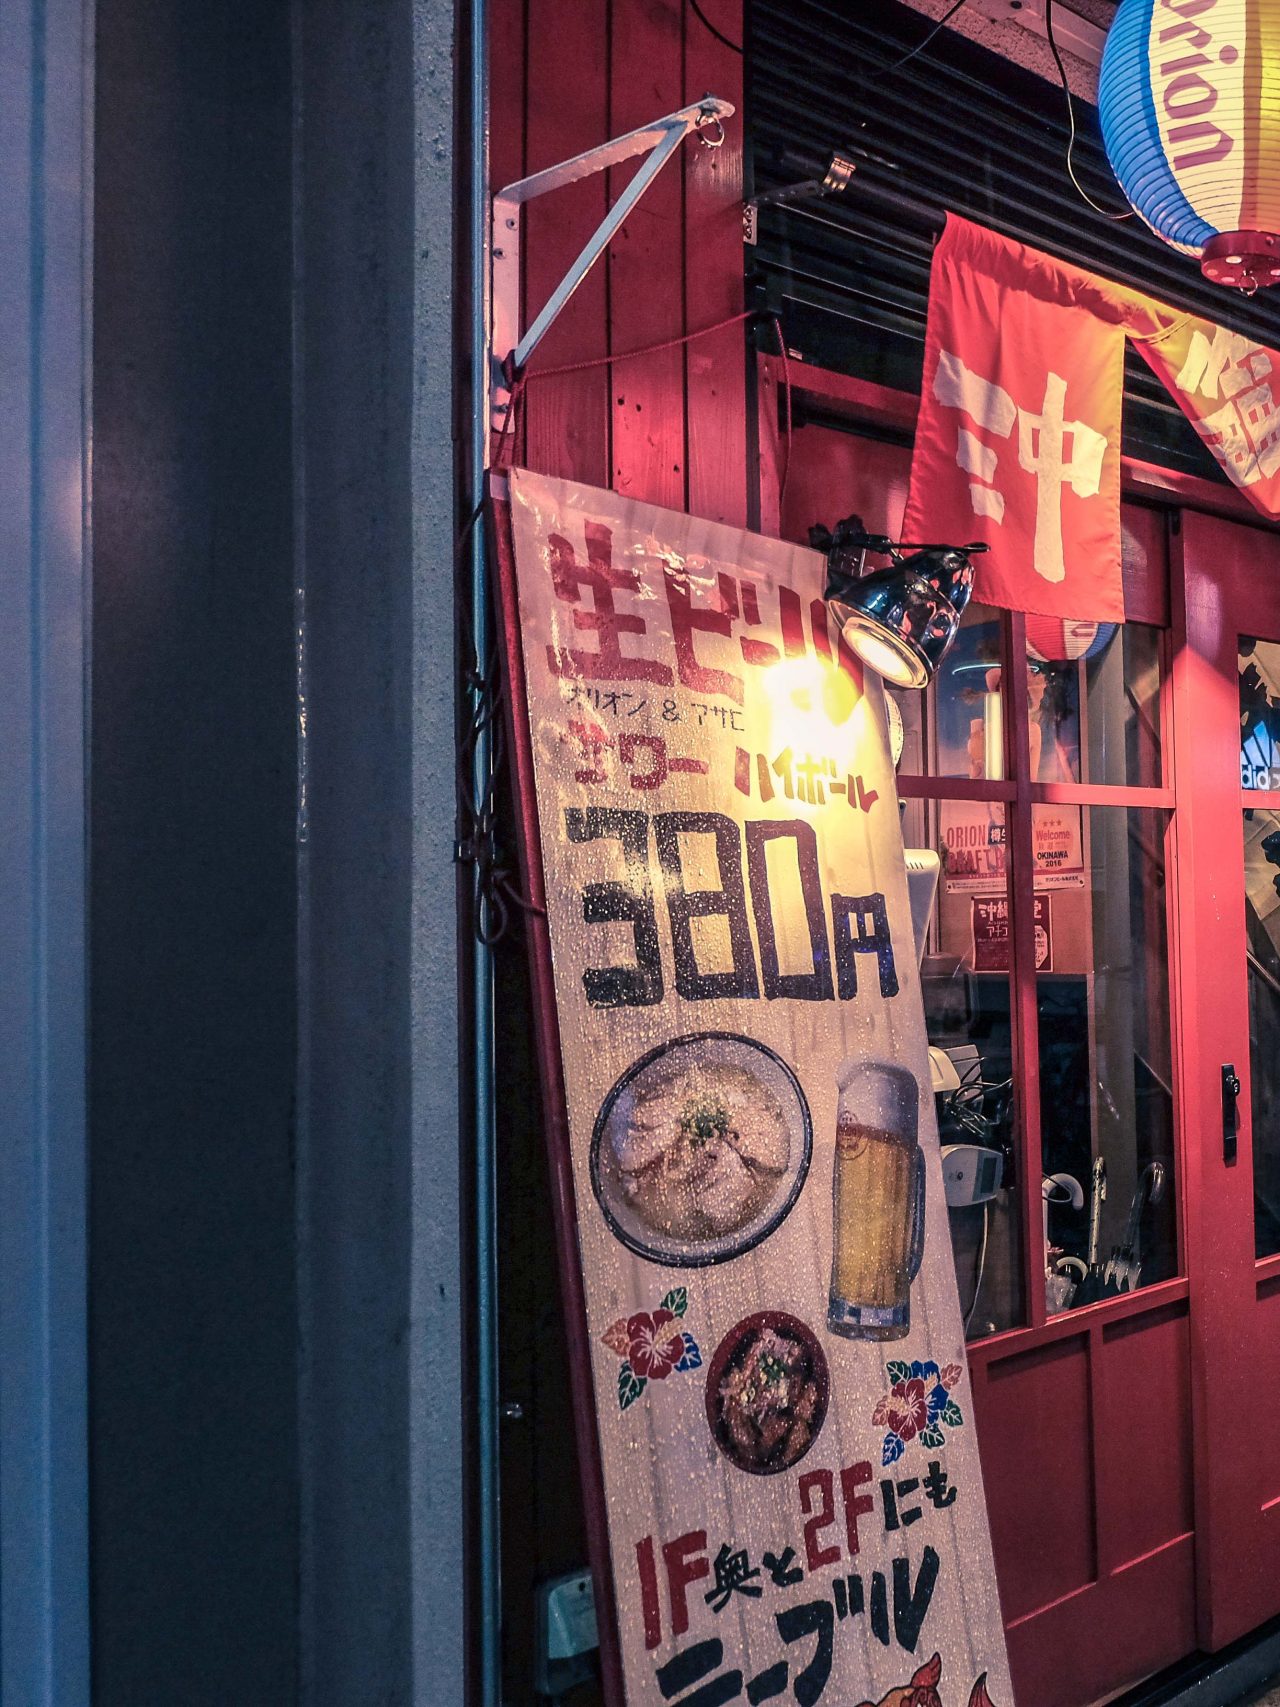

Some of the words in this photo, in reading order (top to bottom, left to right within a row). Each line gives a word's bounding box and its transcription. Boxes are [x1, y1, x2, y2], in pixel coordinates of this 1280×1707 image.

[547, 519, 865, 716] 生ビール
[662, 699, 682, 722] &
[734, 745, 879, 814] ハイボール
[947, 825, 986, 848] ORION
[1035, 829, 1071, 841] Welcome
[1036, 851, 1069, 861] OKINAWA
[565, 806, 900, 1009] 380円
